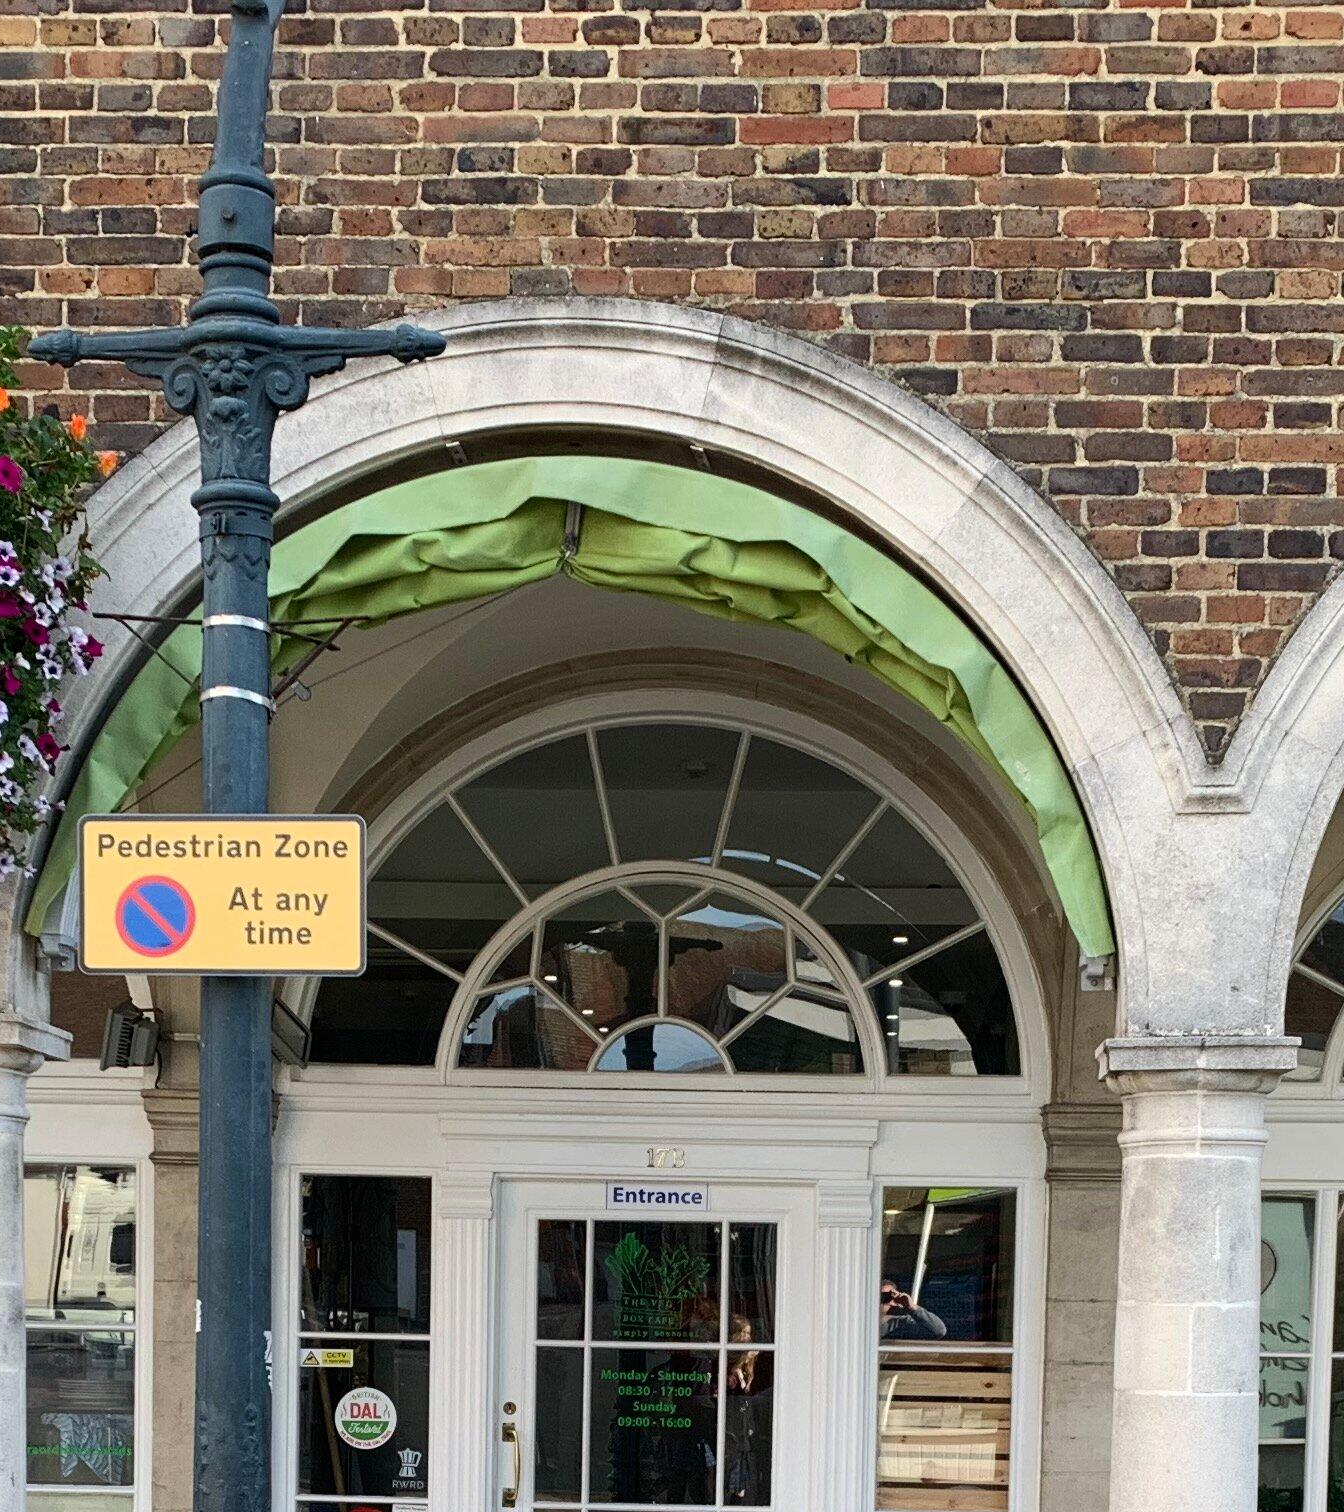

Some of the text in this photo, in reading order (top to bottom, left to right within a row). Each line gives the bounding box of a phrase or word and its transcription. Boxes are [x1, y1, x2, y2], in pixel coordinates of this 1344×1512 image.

[98, 834, 349, 858] Pedestrian Zone
[228, 887, 329, 916] At any
[245, 921, 312, 945] time
[612, 1186, 703, 1204] Entrance
[622, 1296, 646, 1307] THE
[623, 1314, 645, 1323] BOX
[601, 1369, 649, 1382] Monday
[658, 1370, 711, 1384] Saturday
[618, 1385, 651, 1396] 08:30
[661, 1386, 693, 1397] 17:00
[350, 1402, 382, 1419] DAL
[633, 1401, 677, 1414] Sunday
[617, 1416, 650, 1427] 09:00
[660, 1417, 692, 1428] 16:00
[392, 1480, 425, 1490] RWRD
